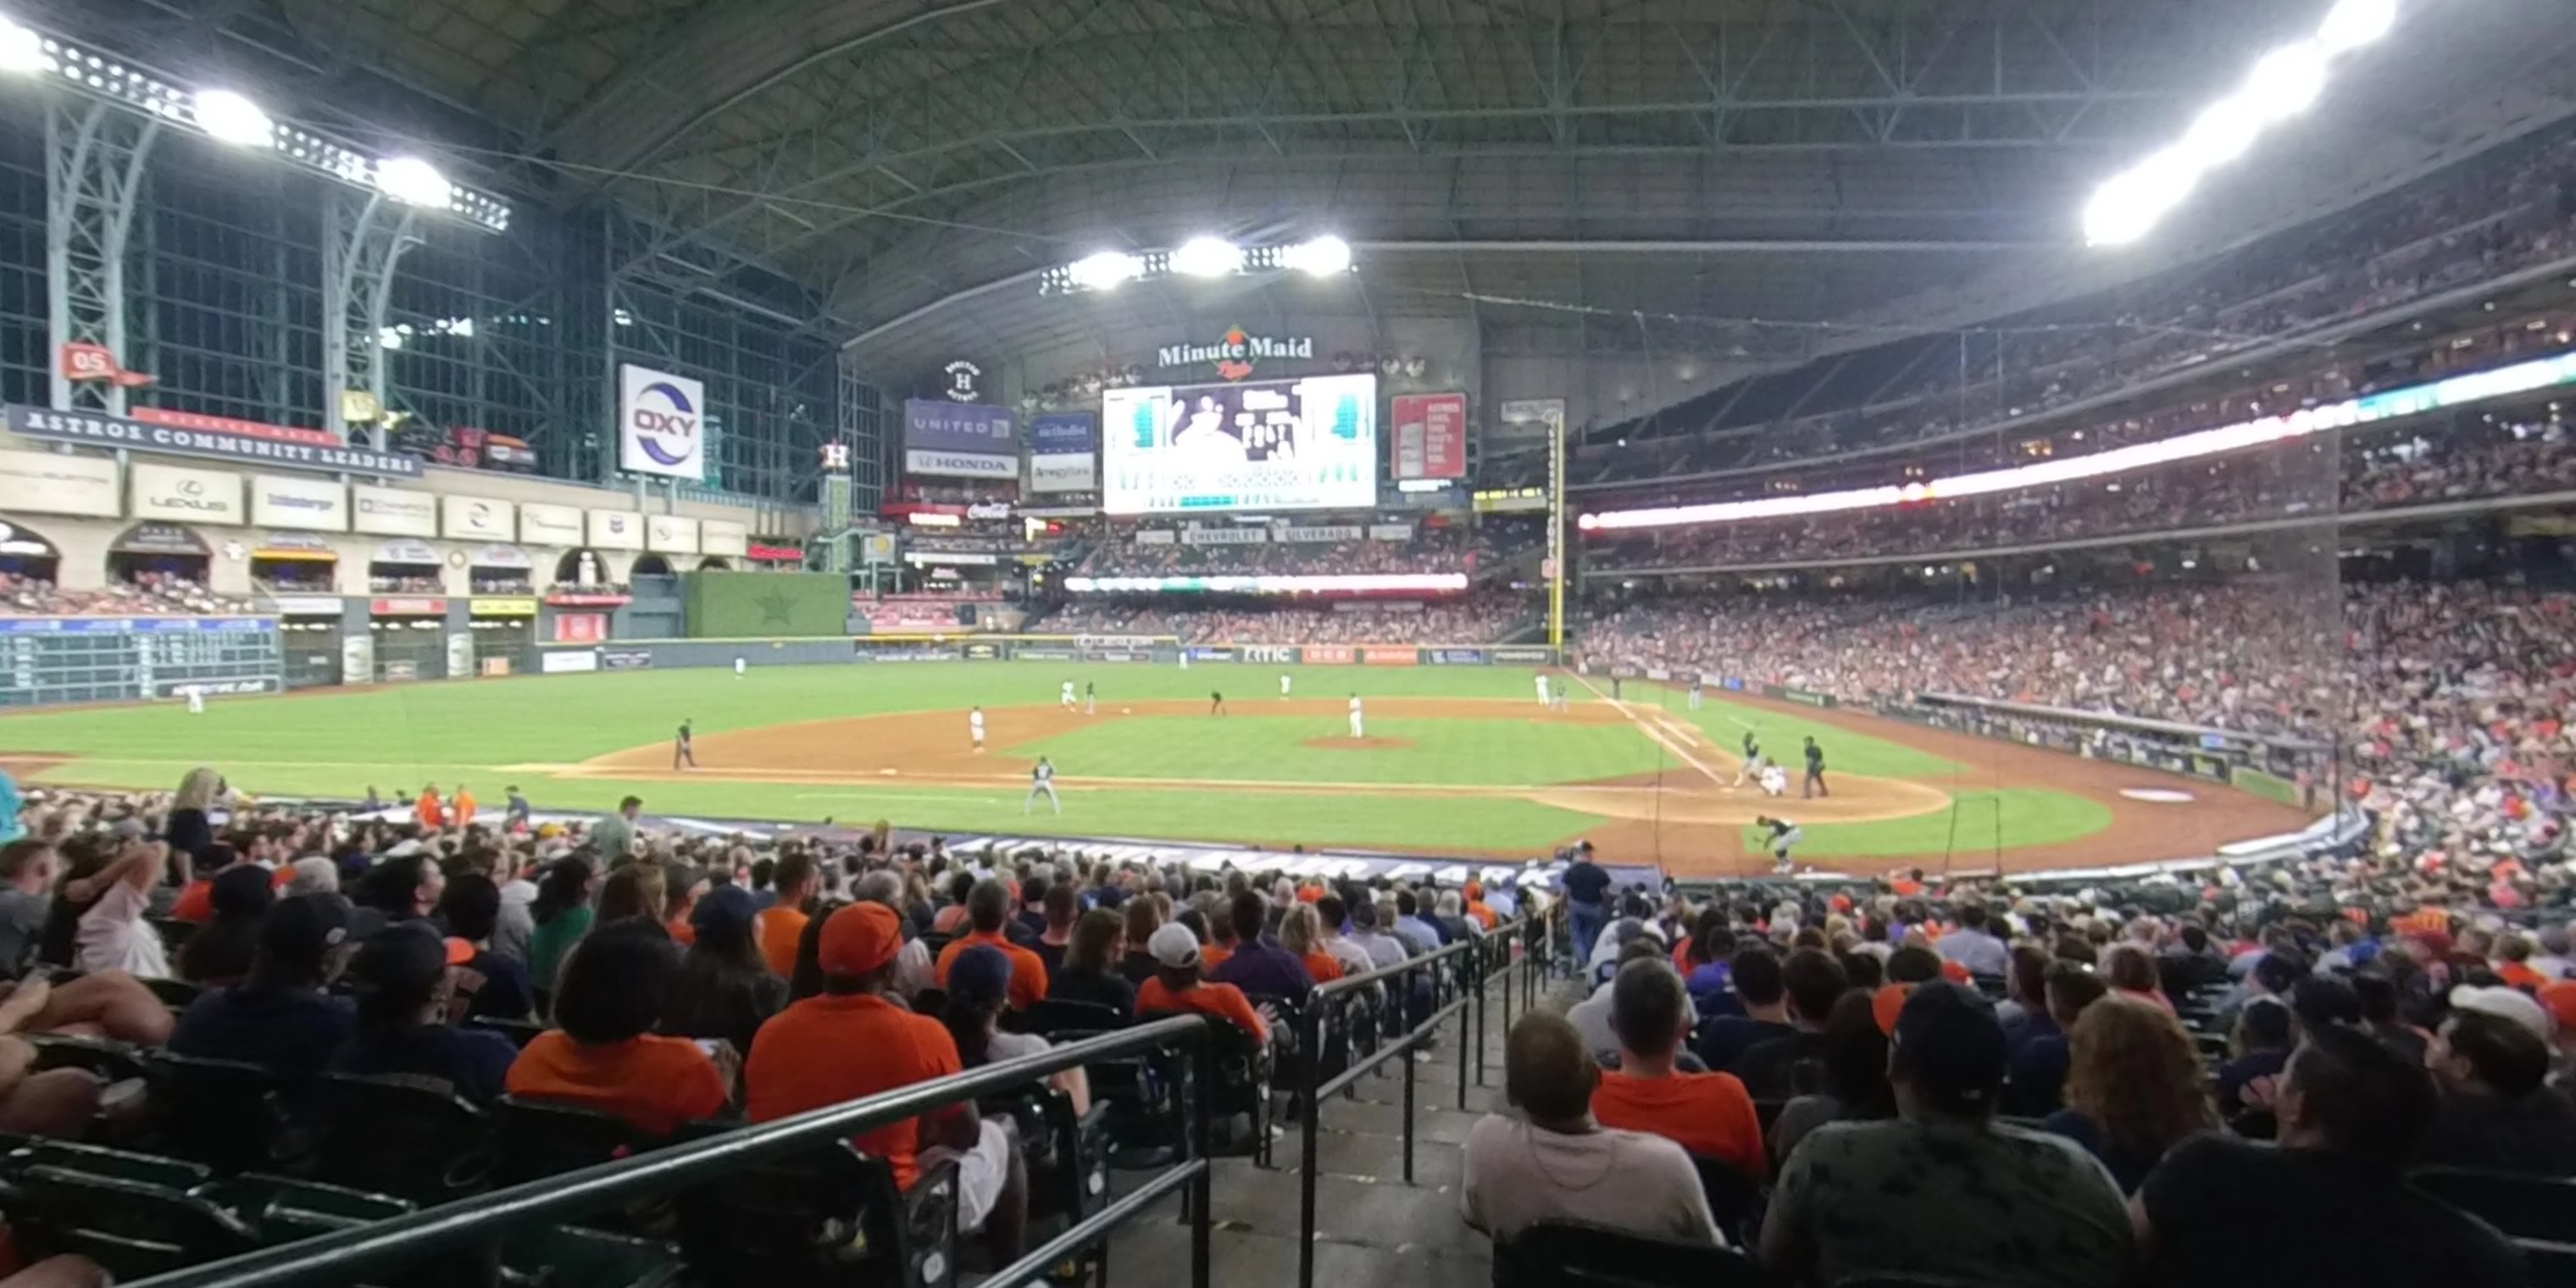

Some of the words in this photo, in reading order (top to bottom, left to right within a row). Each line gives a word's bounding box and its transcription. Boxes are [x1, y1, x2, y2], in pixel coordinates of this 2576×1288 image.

[1158, 341, 1246, 368] Minute
[1249, 336, 1313, 358] Maid
[955, 373, 972, 390] H
[635, 408, 696, 437] OXY
[914, 418, 988, 434] UNITED
[26, 412, 146, 441] ASTROS
[153, 428, 312, 460] COMMUNITY
[321, 448, 414, 472] LEADERS
[935, 458, 1008, 471] HONDA
[150, 497, 228, 512] LEXUS
[1189, 531, 1257, 544] CHEVROLET
[1285, 528, 1353, 541] SILVERADO
